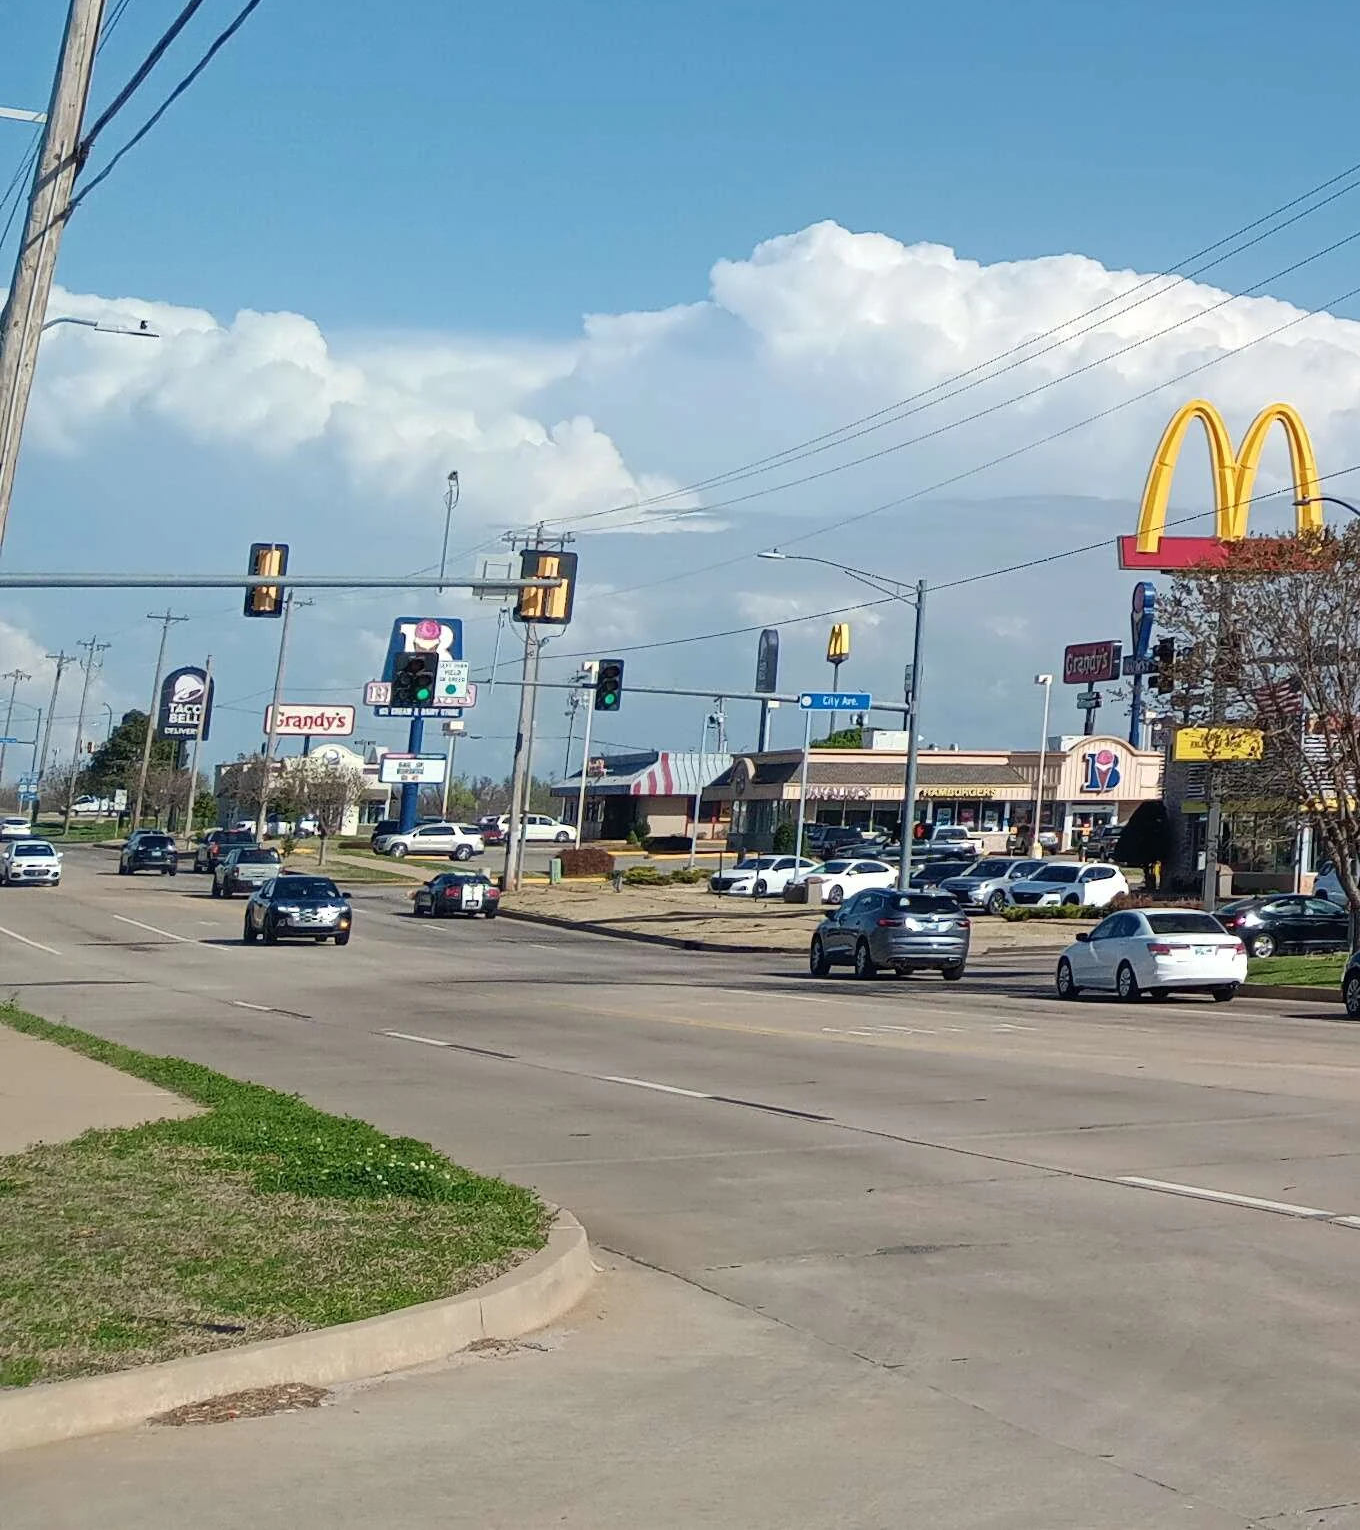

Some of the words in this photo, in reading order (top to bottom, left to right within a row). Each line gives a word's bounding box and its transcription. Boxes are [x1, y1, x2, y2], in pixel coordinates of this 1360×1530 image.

[1066, 647, 1108, 675] Grandy's
[822, 696, 839, 707] City
[168, 703, 201, 714] TACO
[168, 713, 200, 724] BELL
[275, 711, 346, 730] Grandy's
[921, 787, 999, 798] HAMBURGERS
